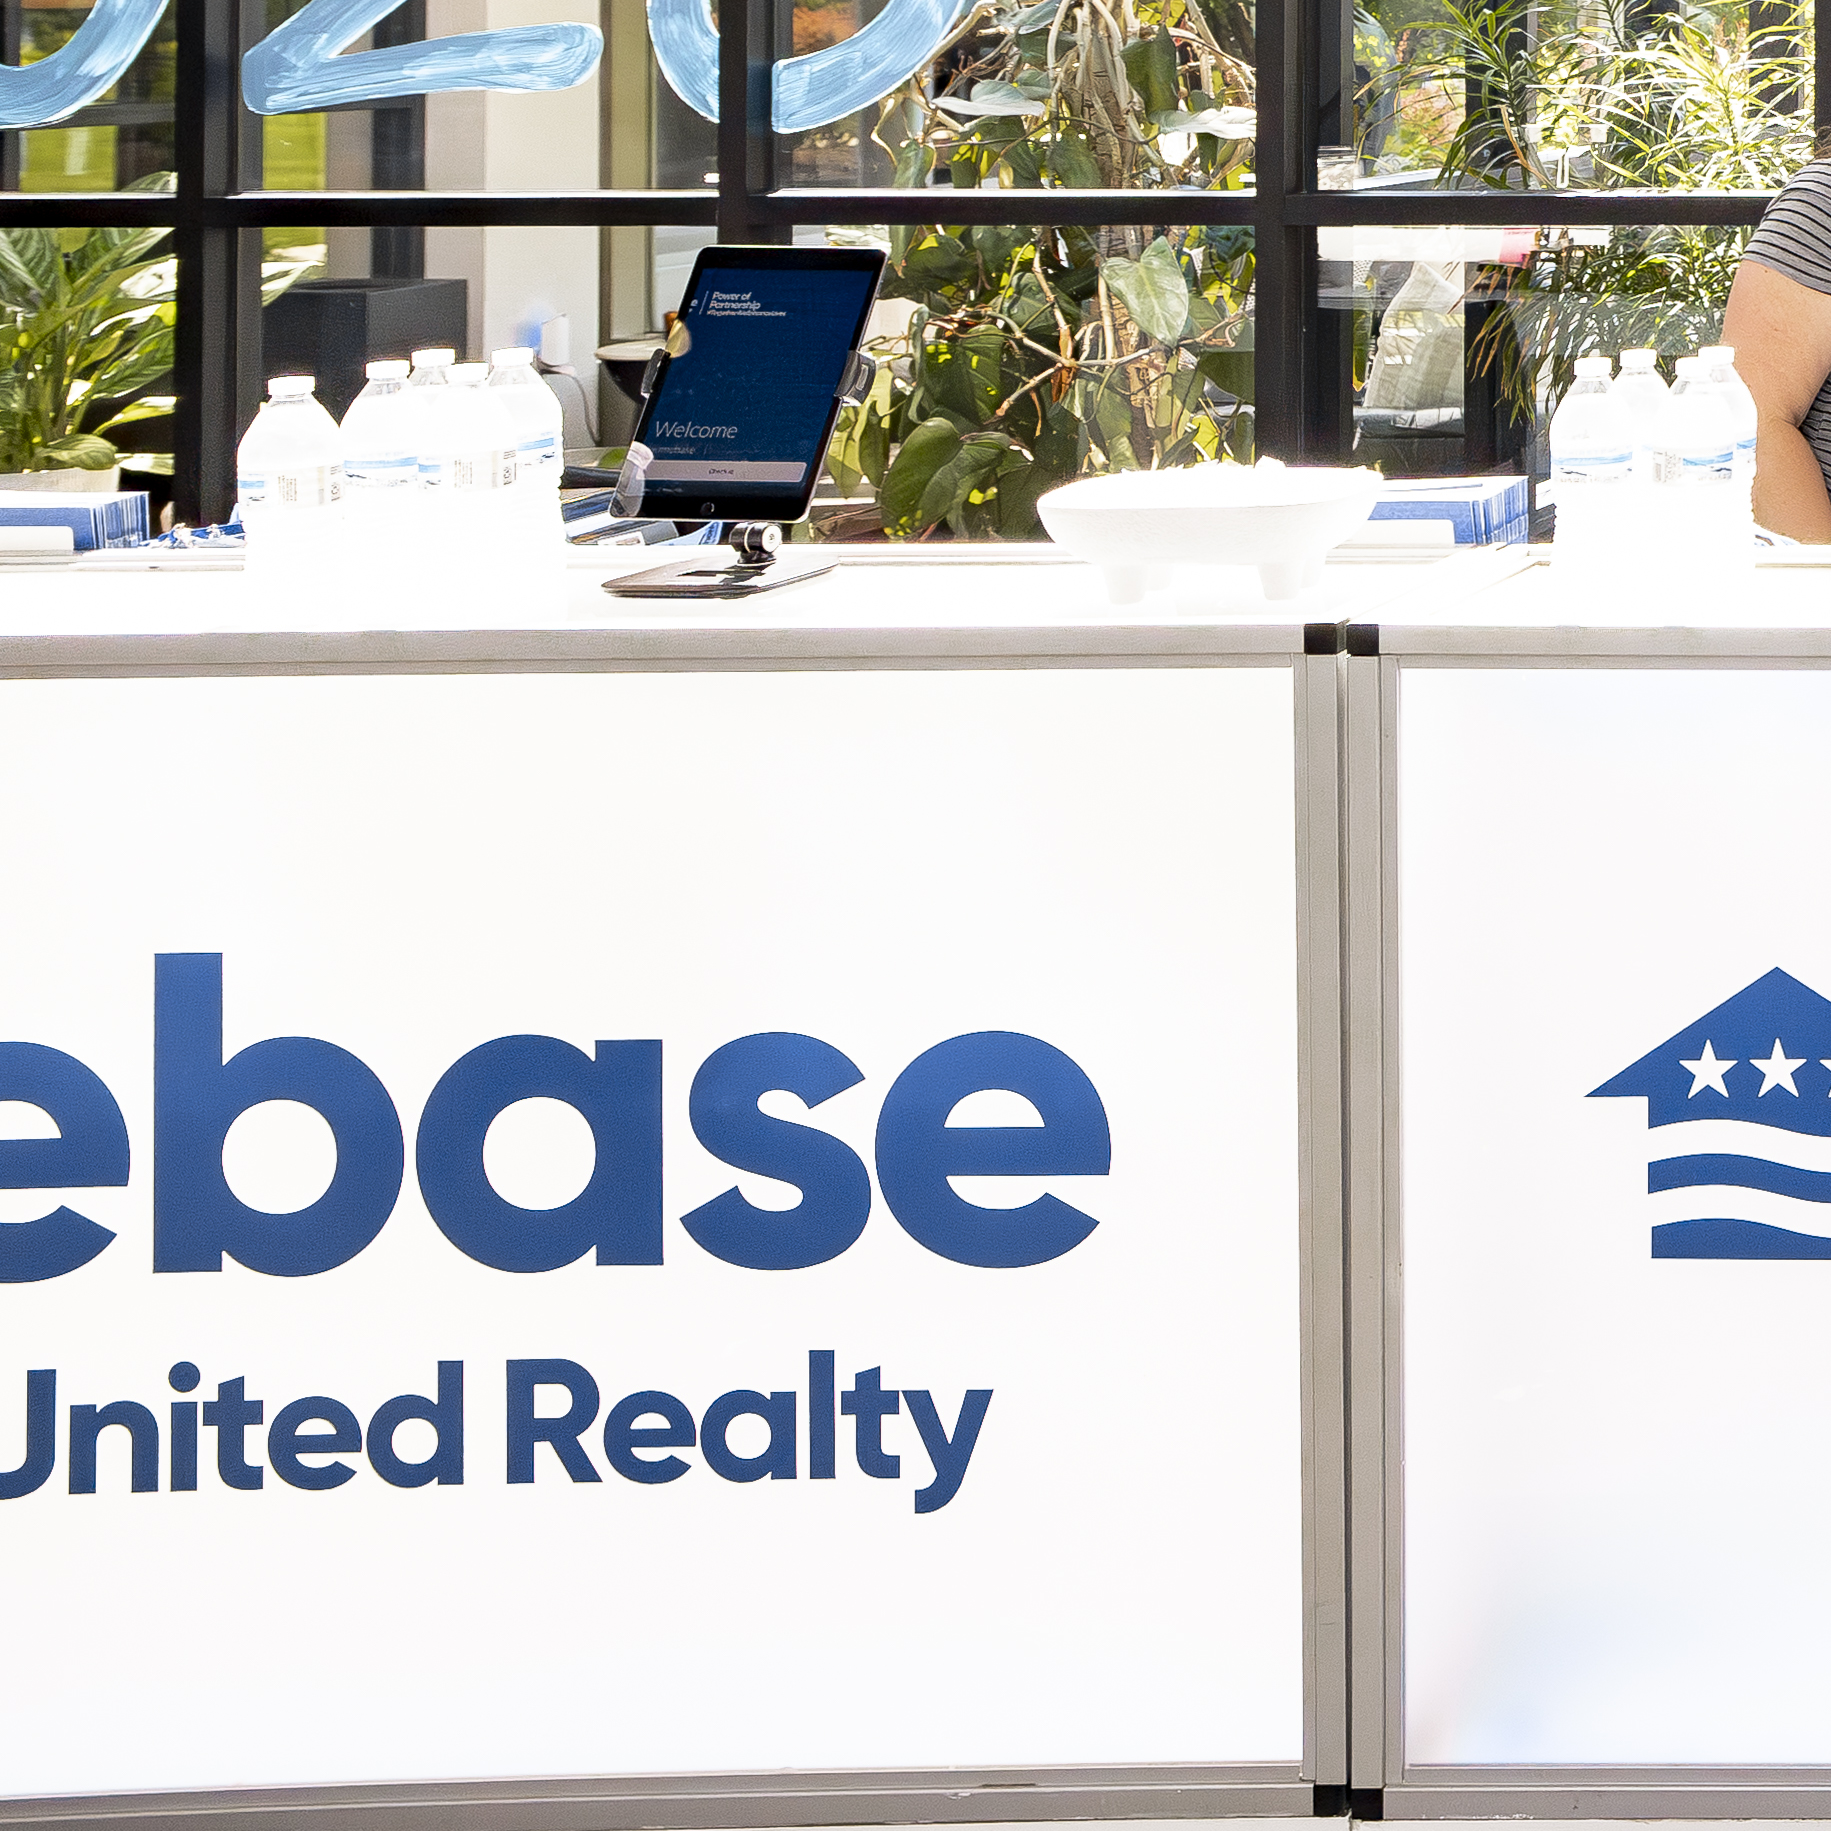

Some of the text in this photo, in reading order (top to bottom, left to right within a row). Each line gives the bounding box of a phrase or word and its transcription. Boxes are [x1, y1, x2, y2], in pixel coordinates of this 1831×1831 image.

[712, 291, 752, 301] Power of
[709, 300, 761, 310] Partnership
[655, 421, 738, 439] Welcome
[507, 1350, 993, 1513] Realty
